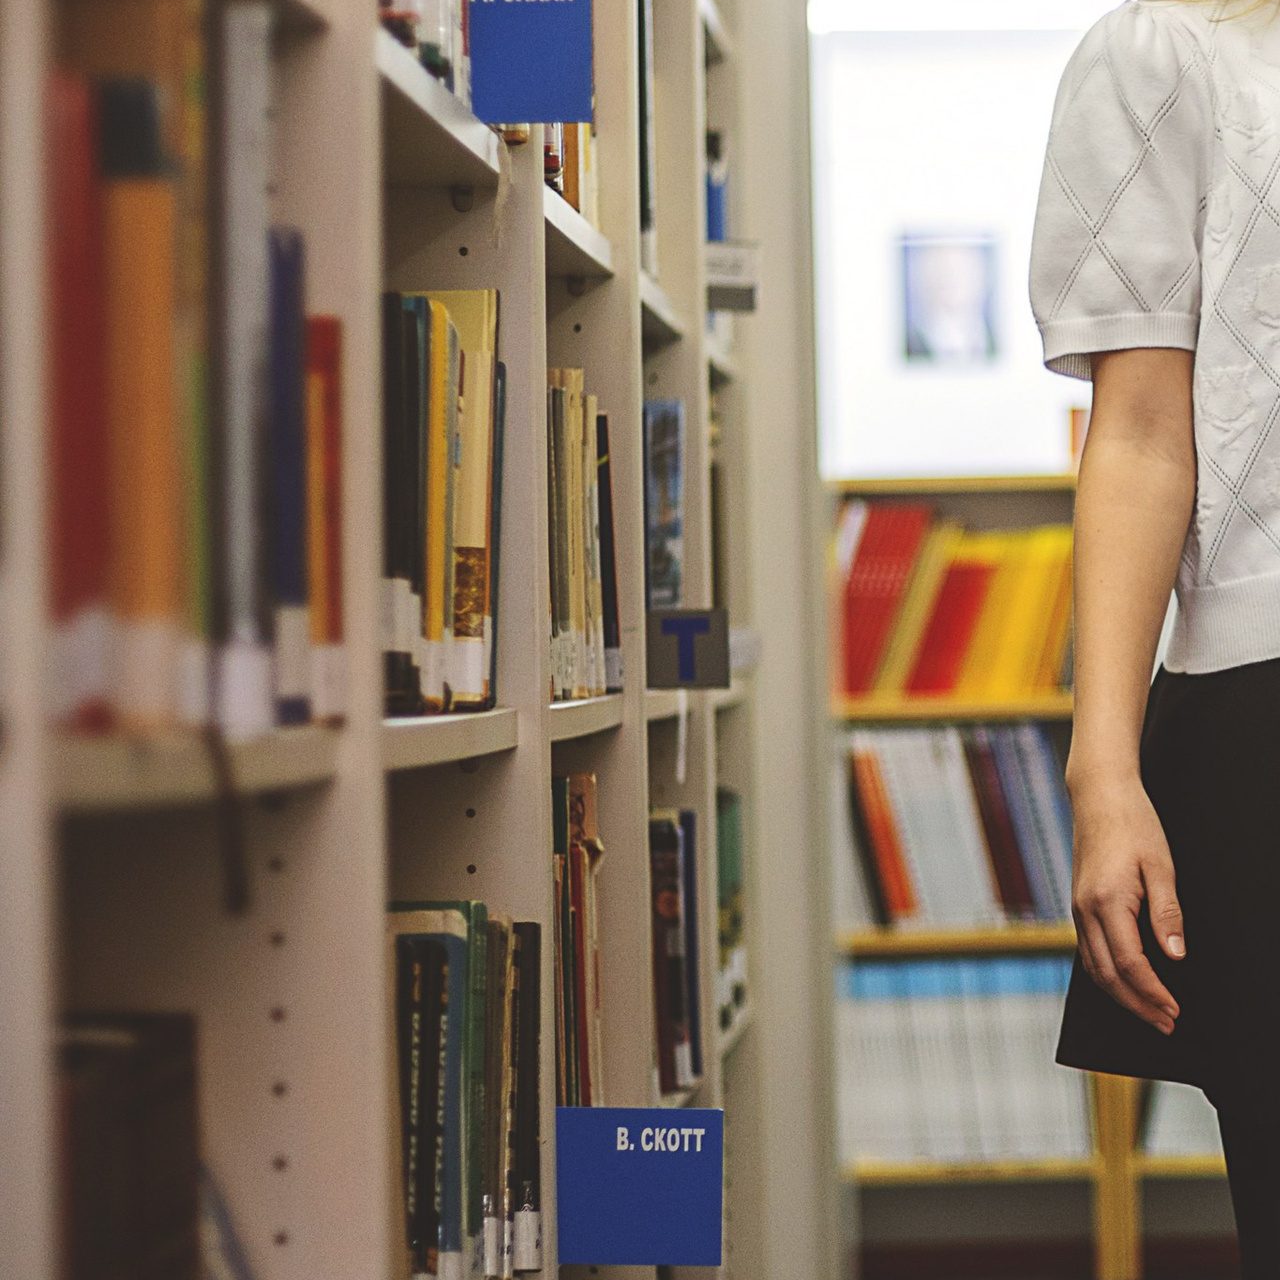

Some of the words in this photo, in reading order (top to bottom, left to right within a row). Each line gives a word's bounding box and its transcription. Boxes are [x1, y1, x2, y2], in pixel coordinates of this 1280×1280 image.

[661, 619, 710, 682] Т
[616, 1127, 635, 1151] В.
[641, 1127, 706, 1152] СКОТТ
